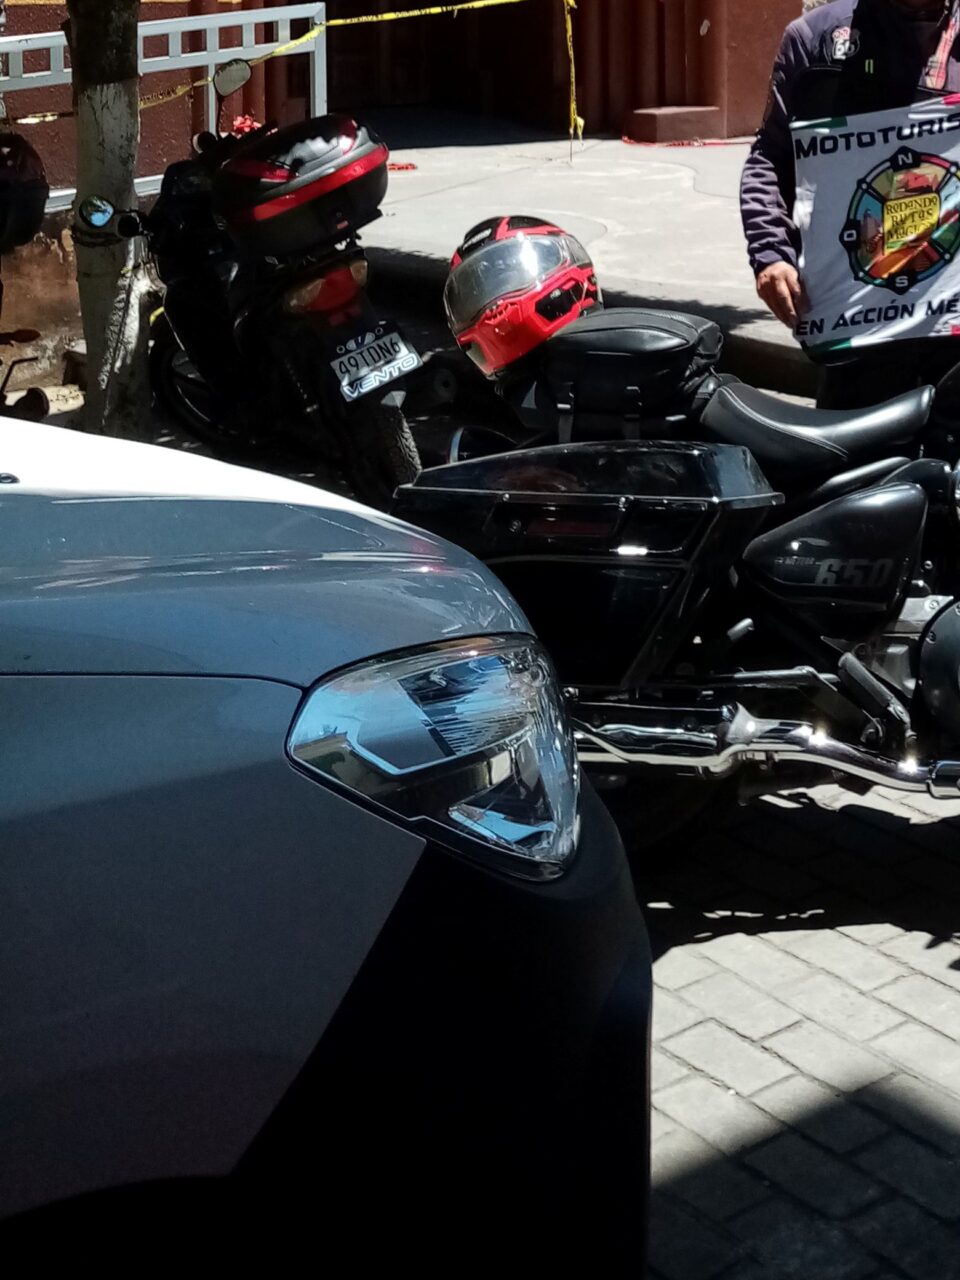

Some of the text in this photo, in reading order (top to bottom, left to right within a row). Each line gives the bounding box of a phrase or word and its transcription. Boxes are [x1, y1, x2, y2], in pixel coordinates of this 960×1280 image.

[796, 318, 824, 336] EN
[832, 299, 915, 331] ACCIÓN
[343, 353, 418, 397] VENTO
[814, 558, 894, 586] 650
